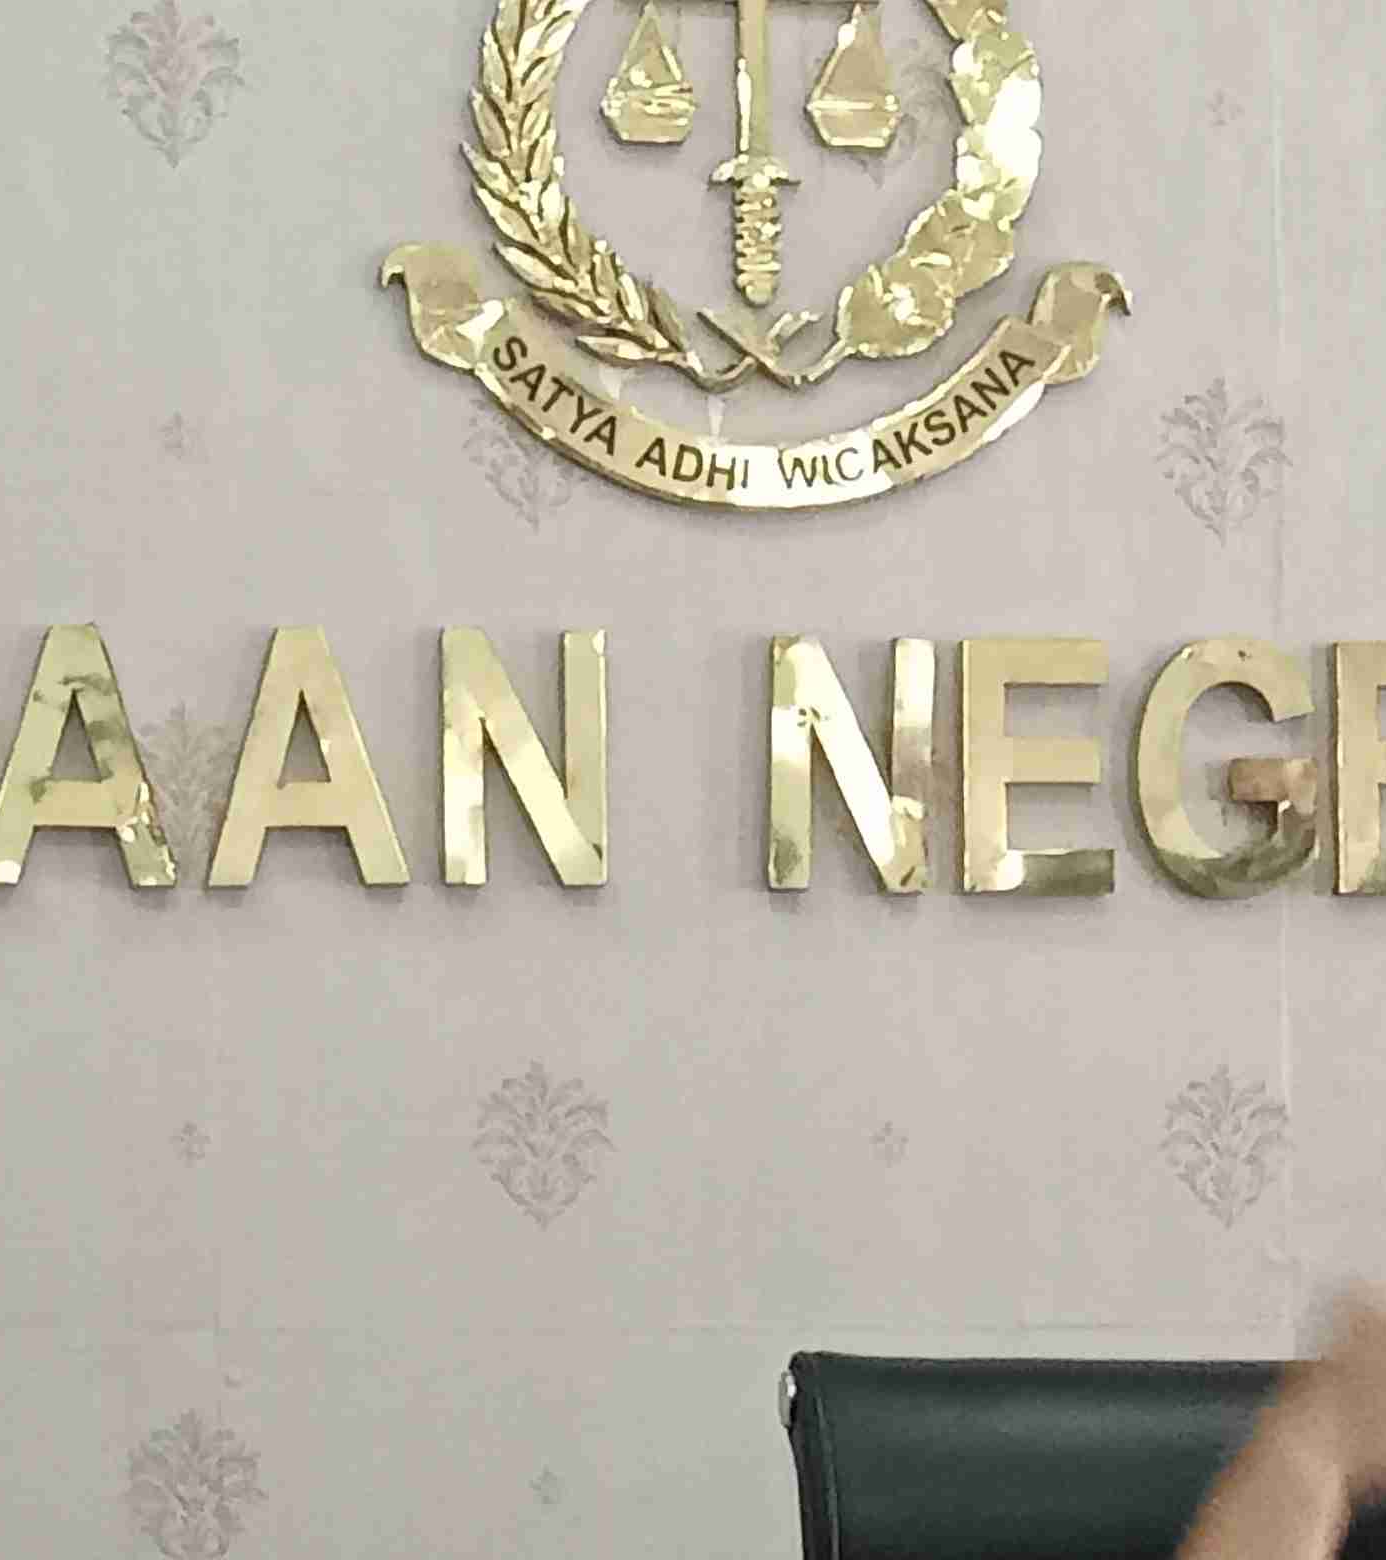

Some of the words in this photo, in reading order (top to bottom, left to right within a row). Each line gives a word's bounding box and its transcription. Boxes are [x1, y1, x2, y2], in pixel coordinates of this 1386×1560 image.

[494, 336, 617, 456] SATYA
[635, 437, 751, 491] ADHI
[776, 347, 1038, 491] WICAKSANA
